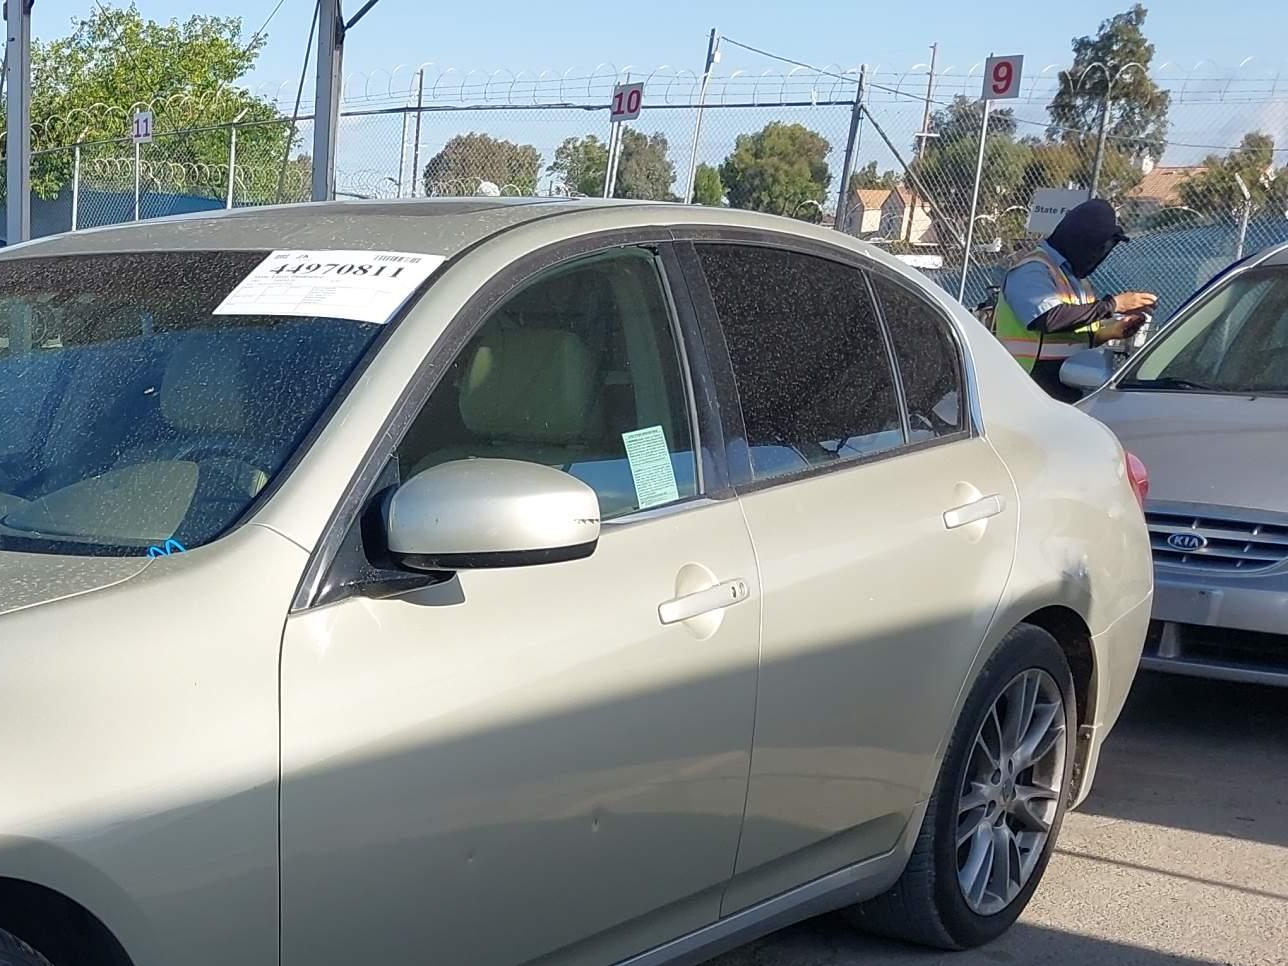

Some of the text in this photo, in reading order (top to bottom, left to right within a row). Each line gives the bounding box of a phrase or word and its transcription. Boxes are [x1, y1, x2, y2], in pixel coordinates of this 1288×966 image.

[992, 61, 1013, 95] 9
[612, 89, 641, 115] 10
[134, 117, 151, 138] 11
[1034, 205, 1058, 215] State
[269, 262, 405, 279] 44970811
[1173, 535, 1199, 548] KIA
